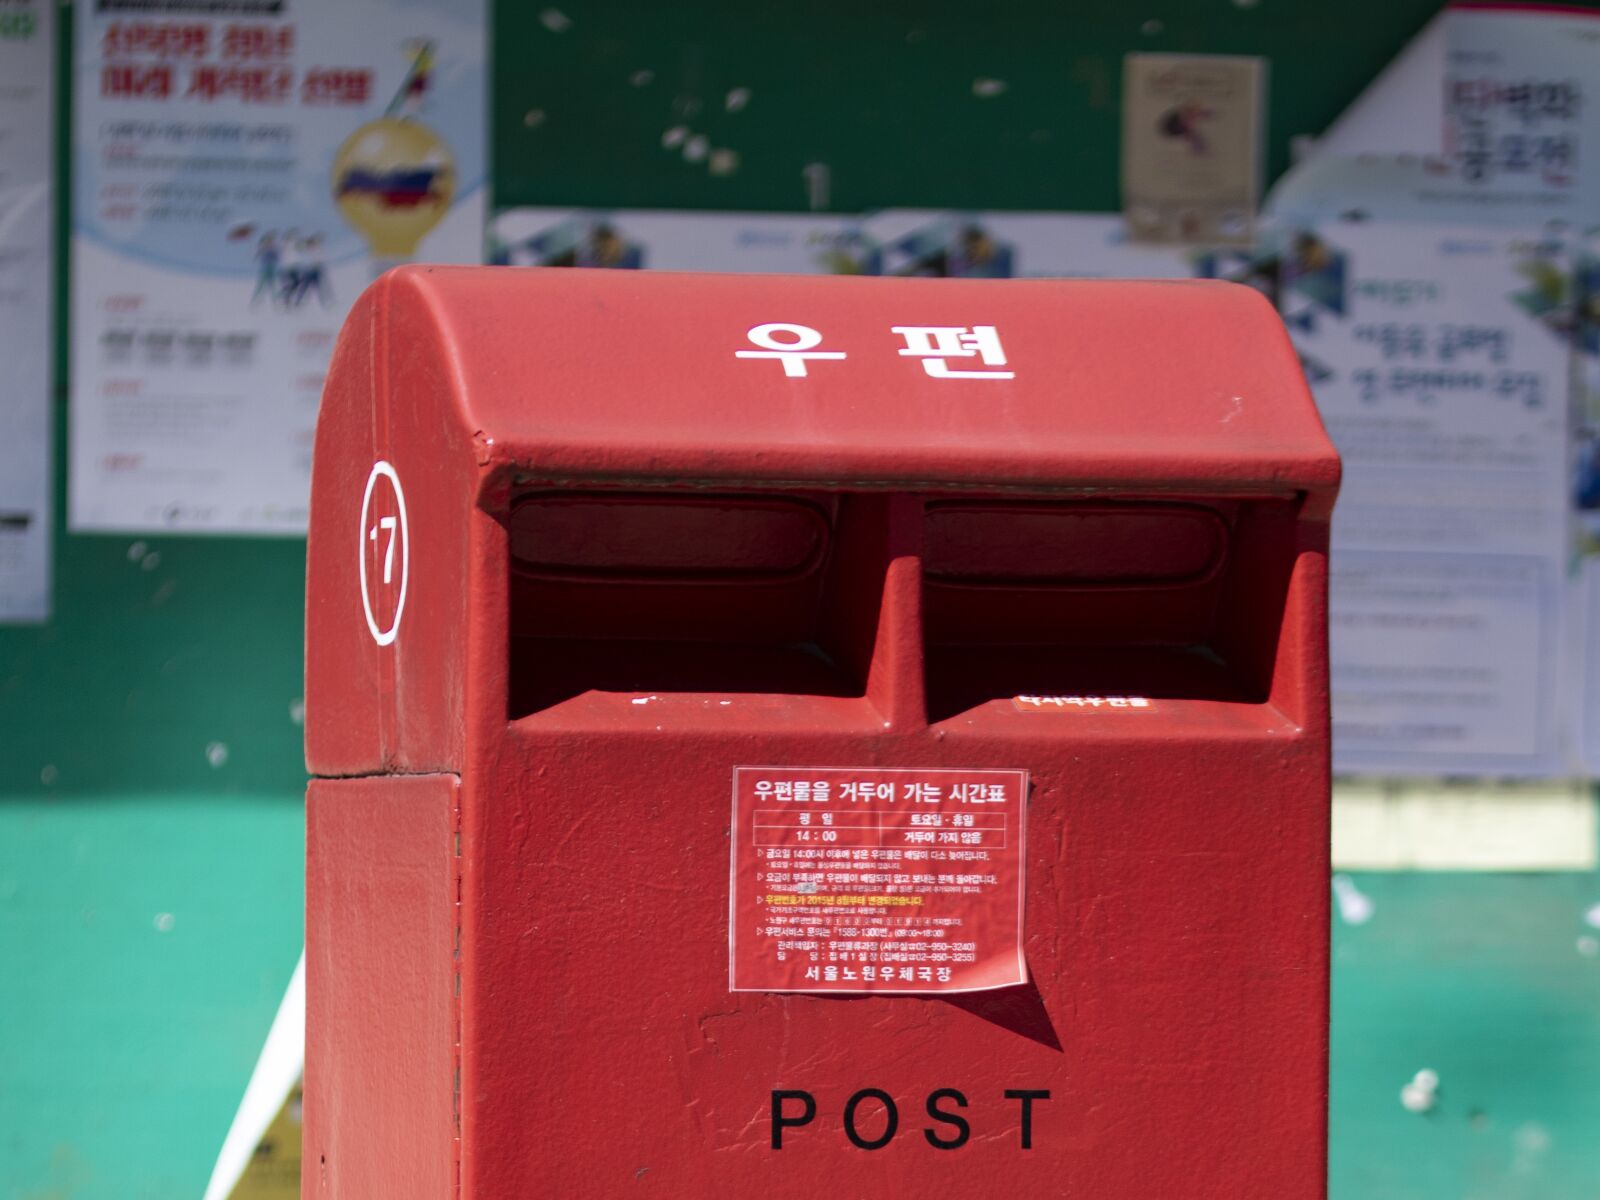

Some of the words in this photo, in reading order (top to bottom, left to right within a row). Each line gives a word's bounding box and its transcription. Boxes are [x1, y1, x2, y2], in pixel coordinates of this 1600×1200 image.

[754, 780, 831, 802] 우편물을
[838, 782, 895, 802] 거두어
[903, 783, 942, 803] 가는
[949, 783, 1007, 804] 시간표
[904, 832, 935, 843] 거두어
[938, 832, 958, 844] 가지
[961, 833, 982, 844] 않음
[765, 927, 804, 937] 우편서비스
[771, 1088, 1050, 1150] POST
